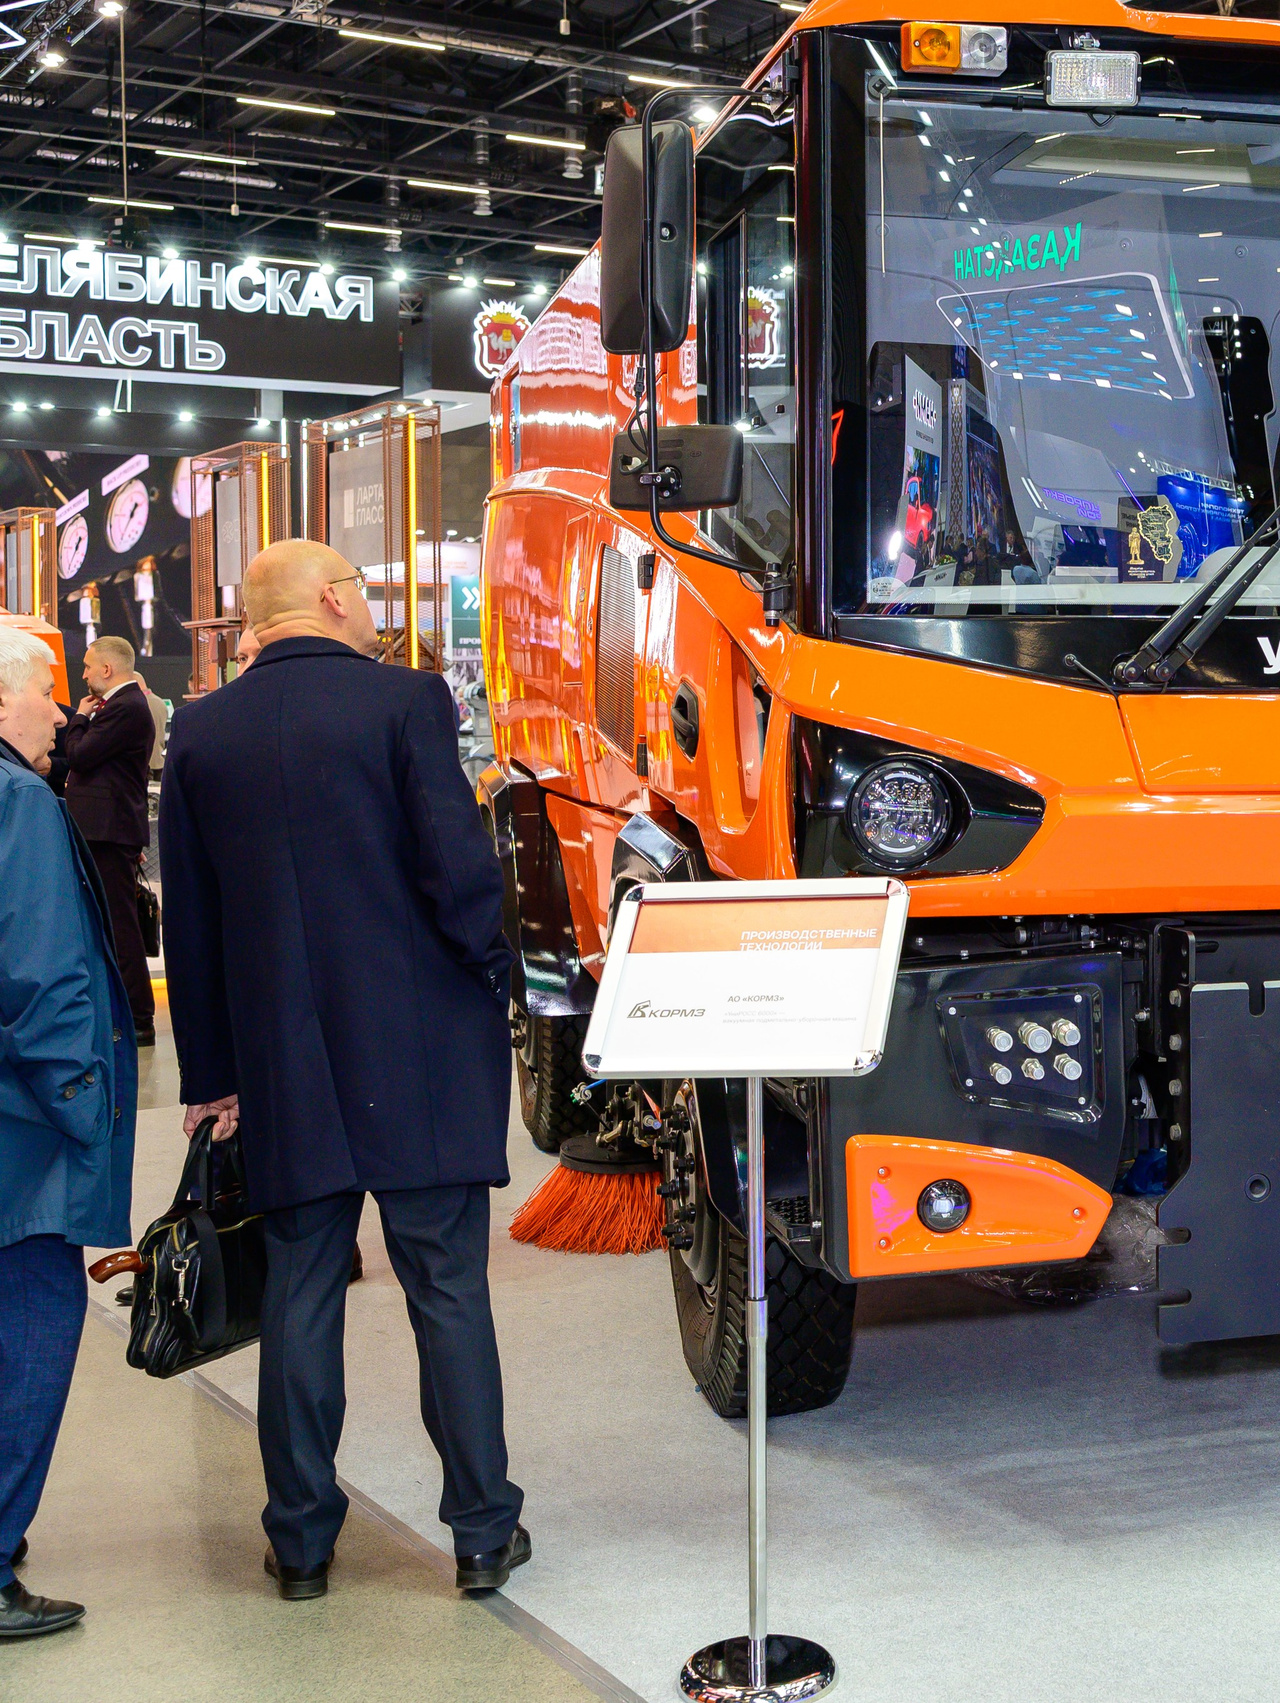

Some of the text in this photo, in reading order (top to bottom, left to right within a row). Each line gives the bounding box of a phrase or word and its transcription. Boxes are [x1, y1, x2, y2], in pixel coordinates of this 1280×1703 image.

[356, 483, 384, 505] ЛАРТА
[356, 504, 385, 526] ГЛАСС
[740, 928, 878, 940] ПРОИЗВОДСТВЕННЫЕ
[739, 941, 823, 951] ТЕХНОЛОГИИ
[727, 995, 741, 1003] АО
